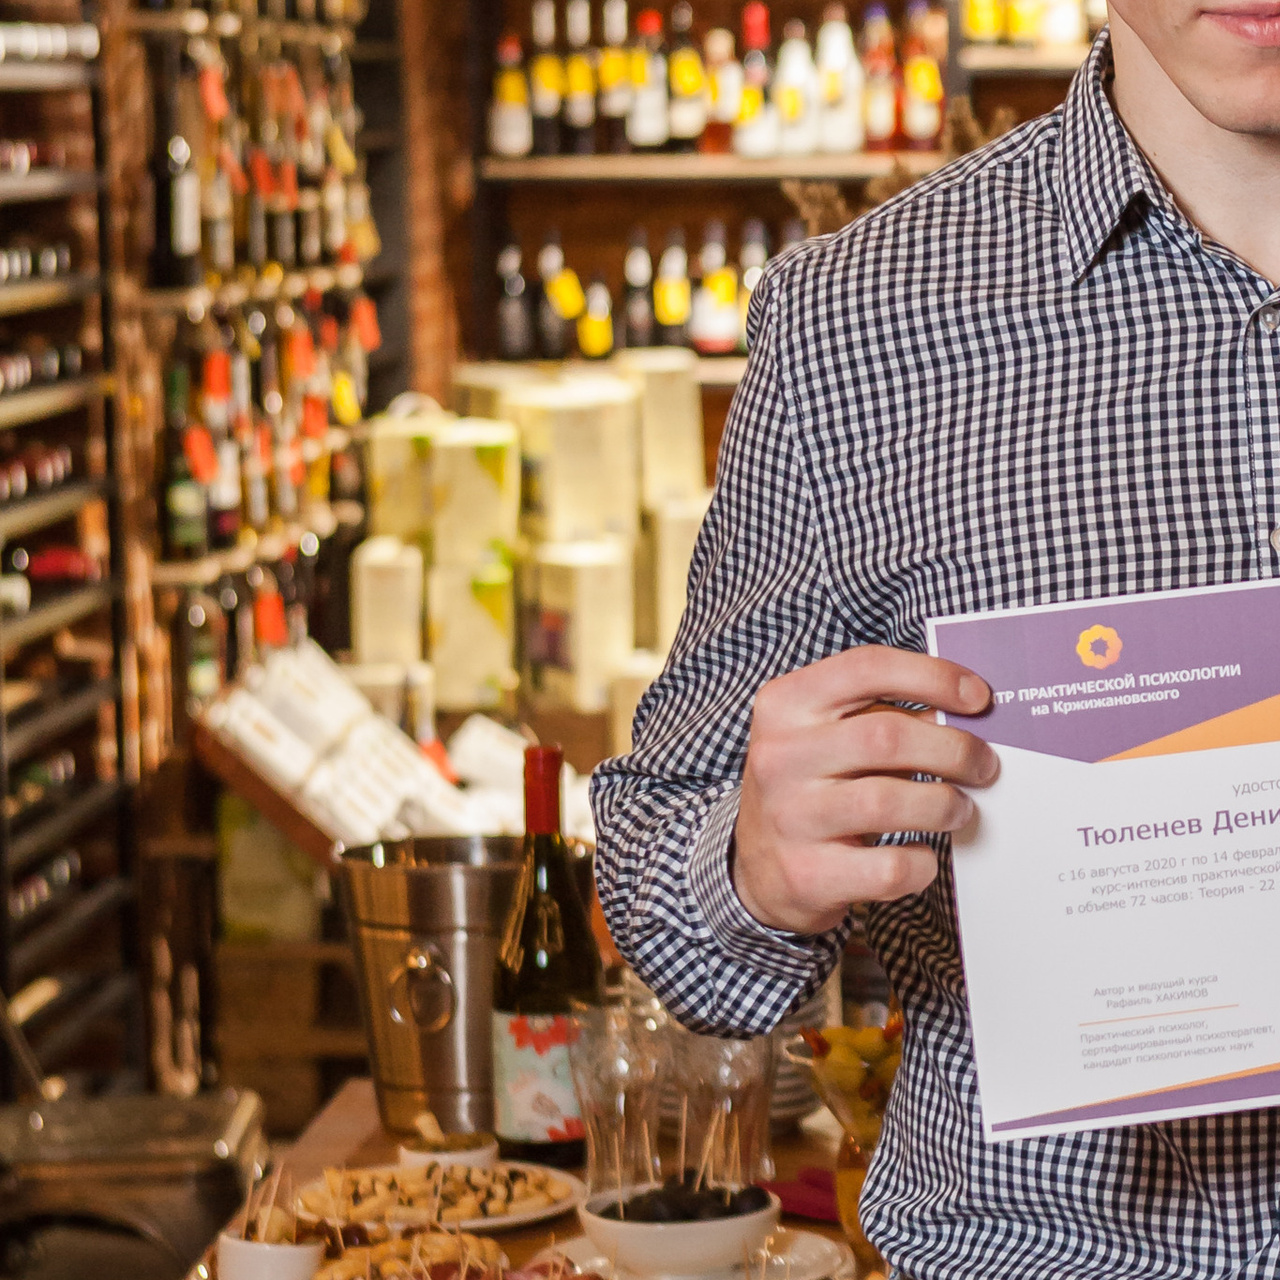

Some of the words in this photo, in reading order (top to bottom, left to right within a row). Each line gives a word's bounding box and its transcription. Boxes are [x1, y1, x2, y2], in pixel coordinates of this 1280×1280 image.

[994, 691, 1015, 705] ТР
[1018, 673, 1135, 702] ПРАКТИЧЕСКОЙ
[1139, 664, 1241, 687] ПСИХОЛОГИИ
[1031, 704, 1049, 716] на
[1053, 688, 1180, 715] Кржижановского
[1077, 818, 1202, 847] Тюленев
[1058, 873, 1066, 882] с
[1070, 866, 1086, 880] 16
[1090, 863, 1140, 880] августа
[1144, 857, 1177, 871] 2020
[1181, 858, 1187, 867] г
[1191, 855, 1208, 866] по
[1214, 851, 1228, 863] 14
[1066, 906, 1073, 915] в
[1078, 897, 1126, 914] объеме
[1131, 895, 1146, 907] 72
[1151, 892, 1193, 904] часов:
[1198, 884, 1245, 900] Теория
[1260, 879, 1275, 891] 22
[1091, 875, 1188, 896] курс-интенсив
[1094, 985, 1124, 997] Автор
[1138, 977, 1184, 992] ведущий
[1189, 974, 1218, 987] курса
[1156, 988, 1208, 1003] ХАКИМОВ
[1080, 1025, 1155, 1044] Практический
[1081, 1035, 1192, 1058] сертифицированный
[1083, 1056, 1132, 1070] кандидат
[1136, 1045, 1226, 1064] психологических
[1230, 1041, 1254, 1052] наук
